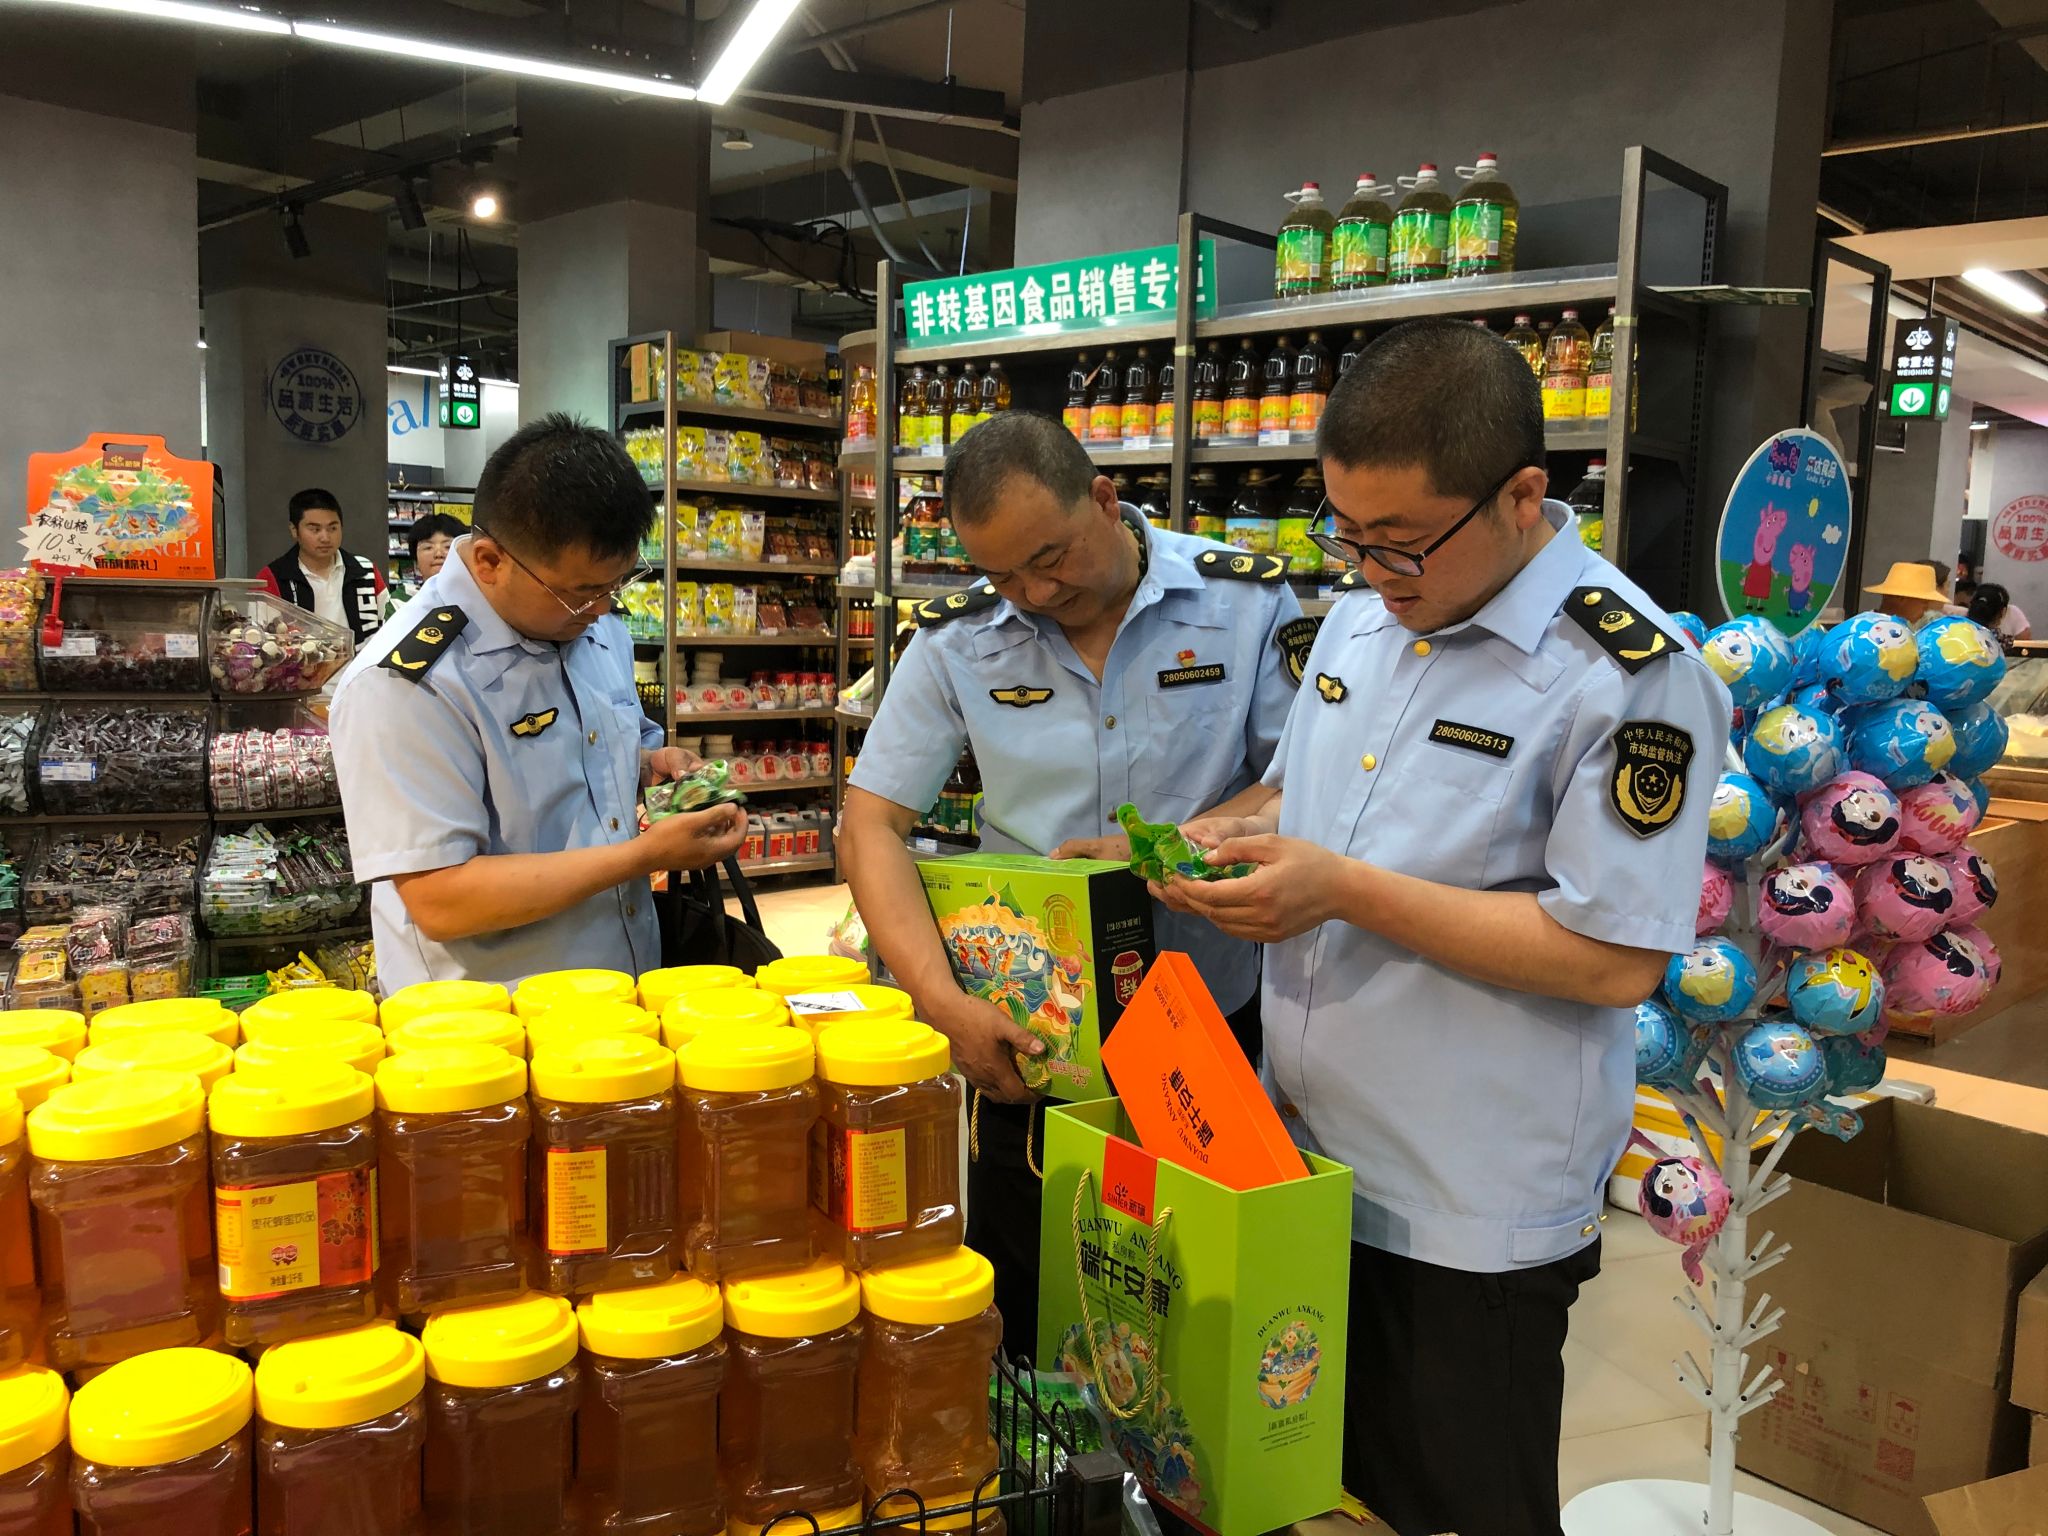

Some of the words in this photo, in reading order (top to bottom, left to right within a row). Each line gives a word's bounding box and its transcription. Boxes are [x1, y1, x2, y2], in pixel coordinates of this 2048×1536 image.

[297, 374, 335, 390] 100%
[1998, 525, 2048, 541] 品质生
[1163, 667, 1221, 683] 28050602459
[1433, 723, 1509, 752] 28050602513
[1623, 727, 1690, 754] 中华人民共和国
[1628, 741, 1684, 765] 市场监管执法
[1119, 976, 1138, 999] 粽
[1161, 1072, 1178, 1123] ANKANG
[1177, 1127, 1209, 1165] DUANWU
[1073, 1217, 1123, 1237] UANWU
[1129, 1231, 1183, 1290] ANANG
[1080, 1238, 1171, 1318] 端午安康
[1257, 1306, 1292, 1339] DUANWU
[1295, 1304, 1326, 1323] ANKANG
